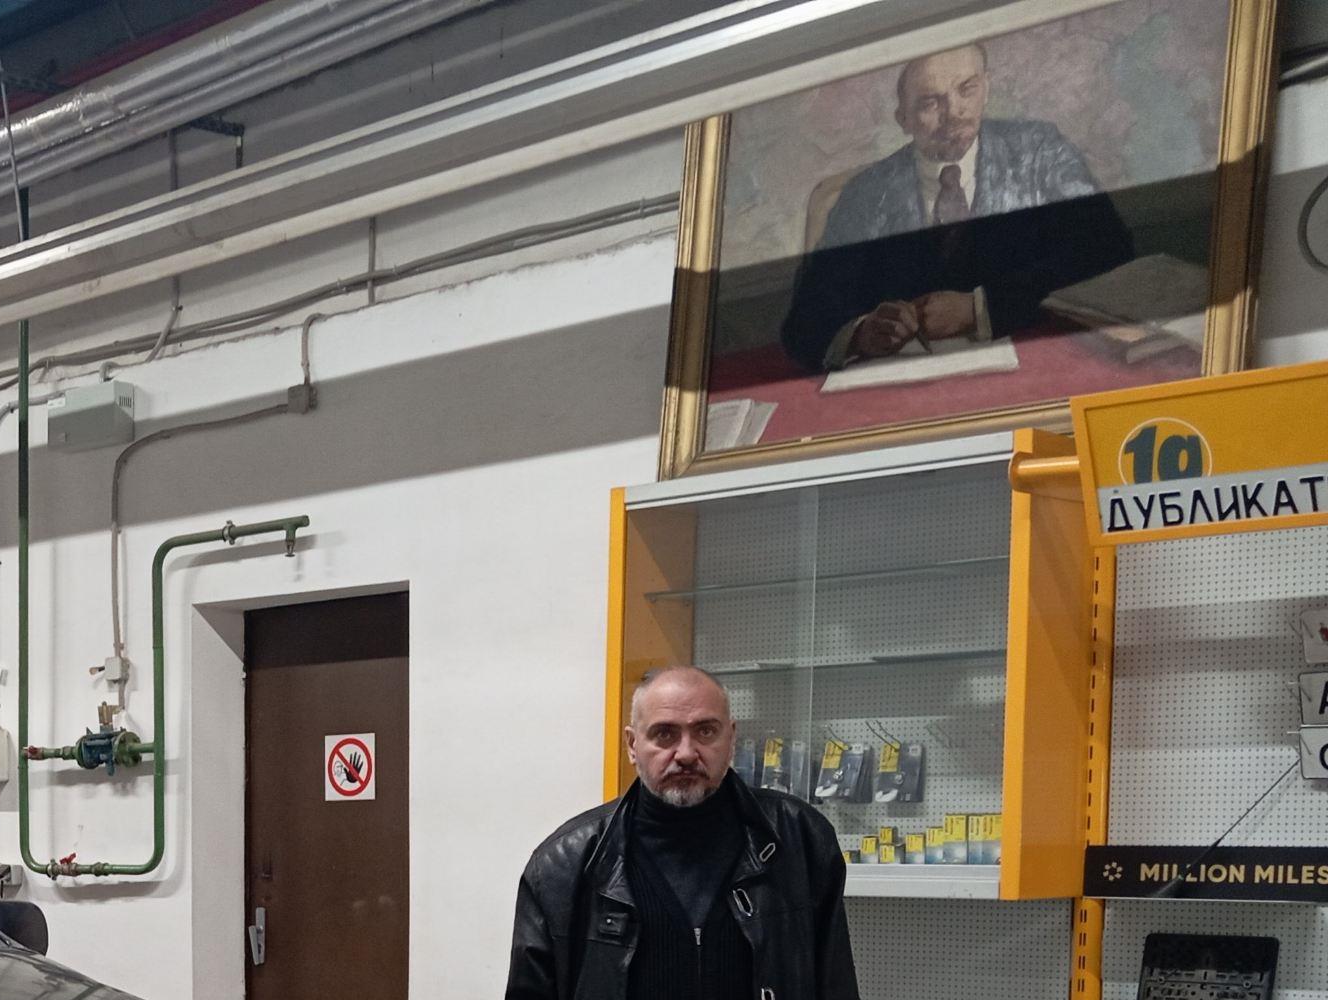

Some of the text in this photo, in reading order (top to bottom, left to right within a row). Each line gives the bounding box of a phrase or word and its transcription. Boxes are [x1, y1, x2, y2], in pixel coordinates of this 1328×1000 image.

[1107, 475, 1324, 533] ДУБЛИКАТ
[1139, 863, 1328, 885] MILLION MILES
